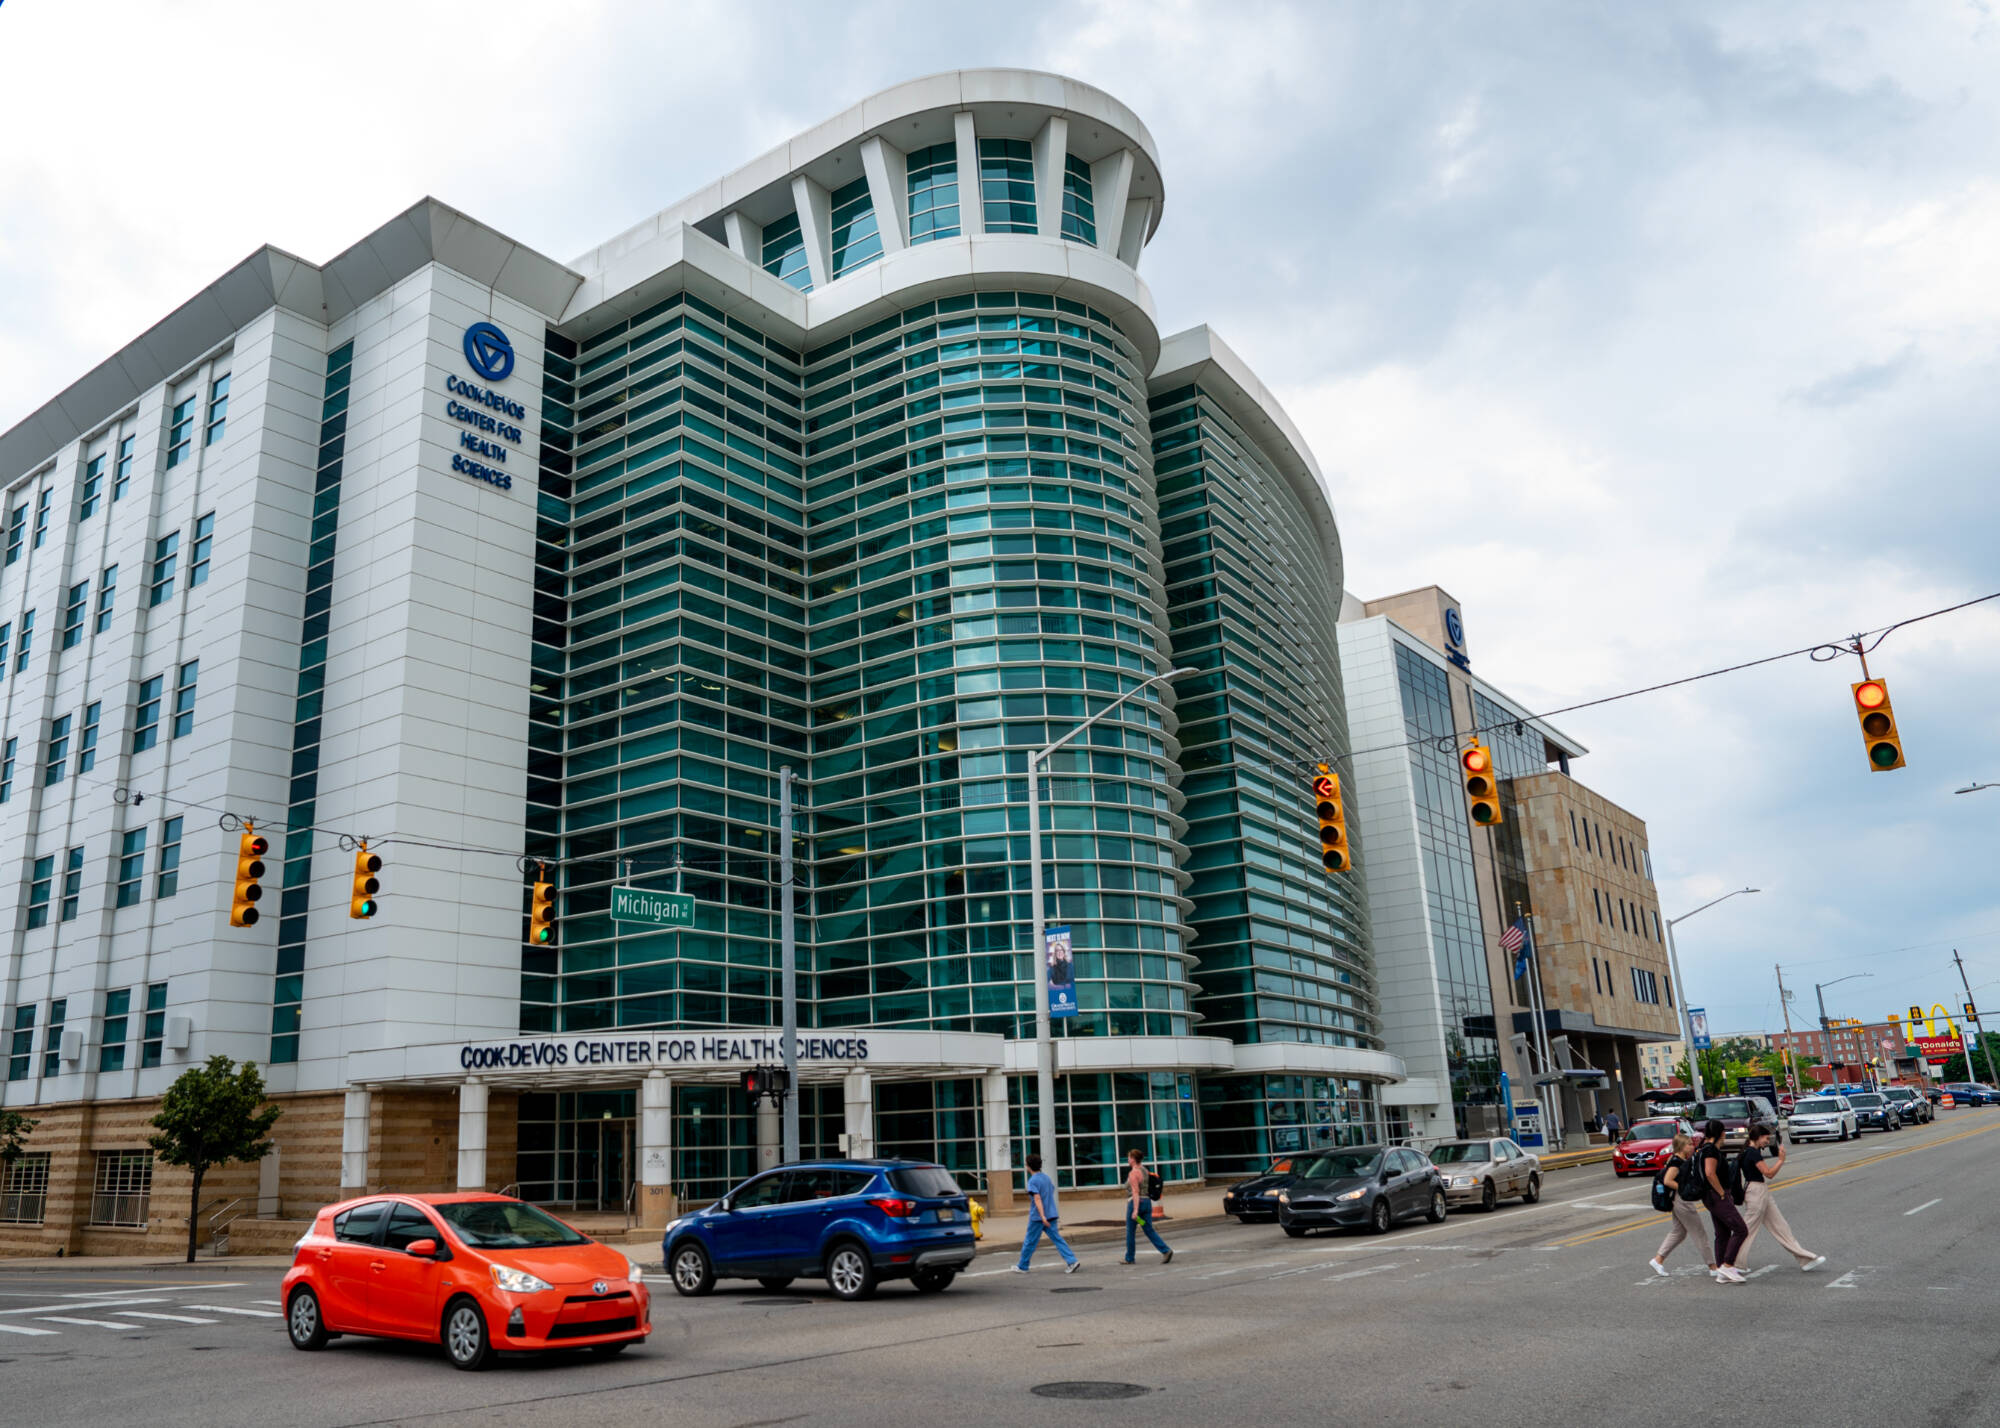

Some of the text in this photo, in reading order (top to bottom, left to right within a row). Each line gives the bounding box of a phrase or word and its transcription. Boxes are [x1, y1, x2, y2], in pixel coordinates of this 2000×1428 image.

[447, 400, 522, 445] CENTER FOR
[460, 431, 507, 464] HEALTH
[452, 453, 512, 491] SCIENCES
[617, 894, 679, 922] Michigan
[574, 1040, 652, 1064] CENTER
[657, 1040, 697, 1062] FOR
[702, 1037, 775, 1061] HEALTH
[649, 1187, 664, 1196] 301
